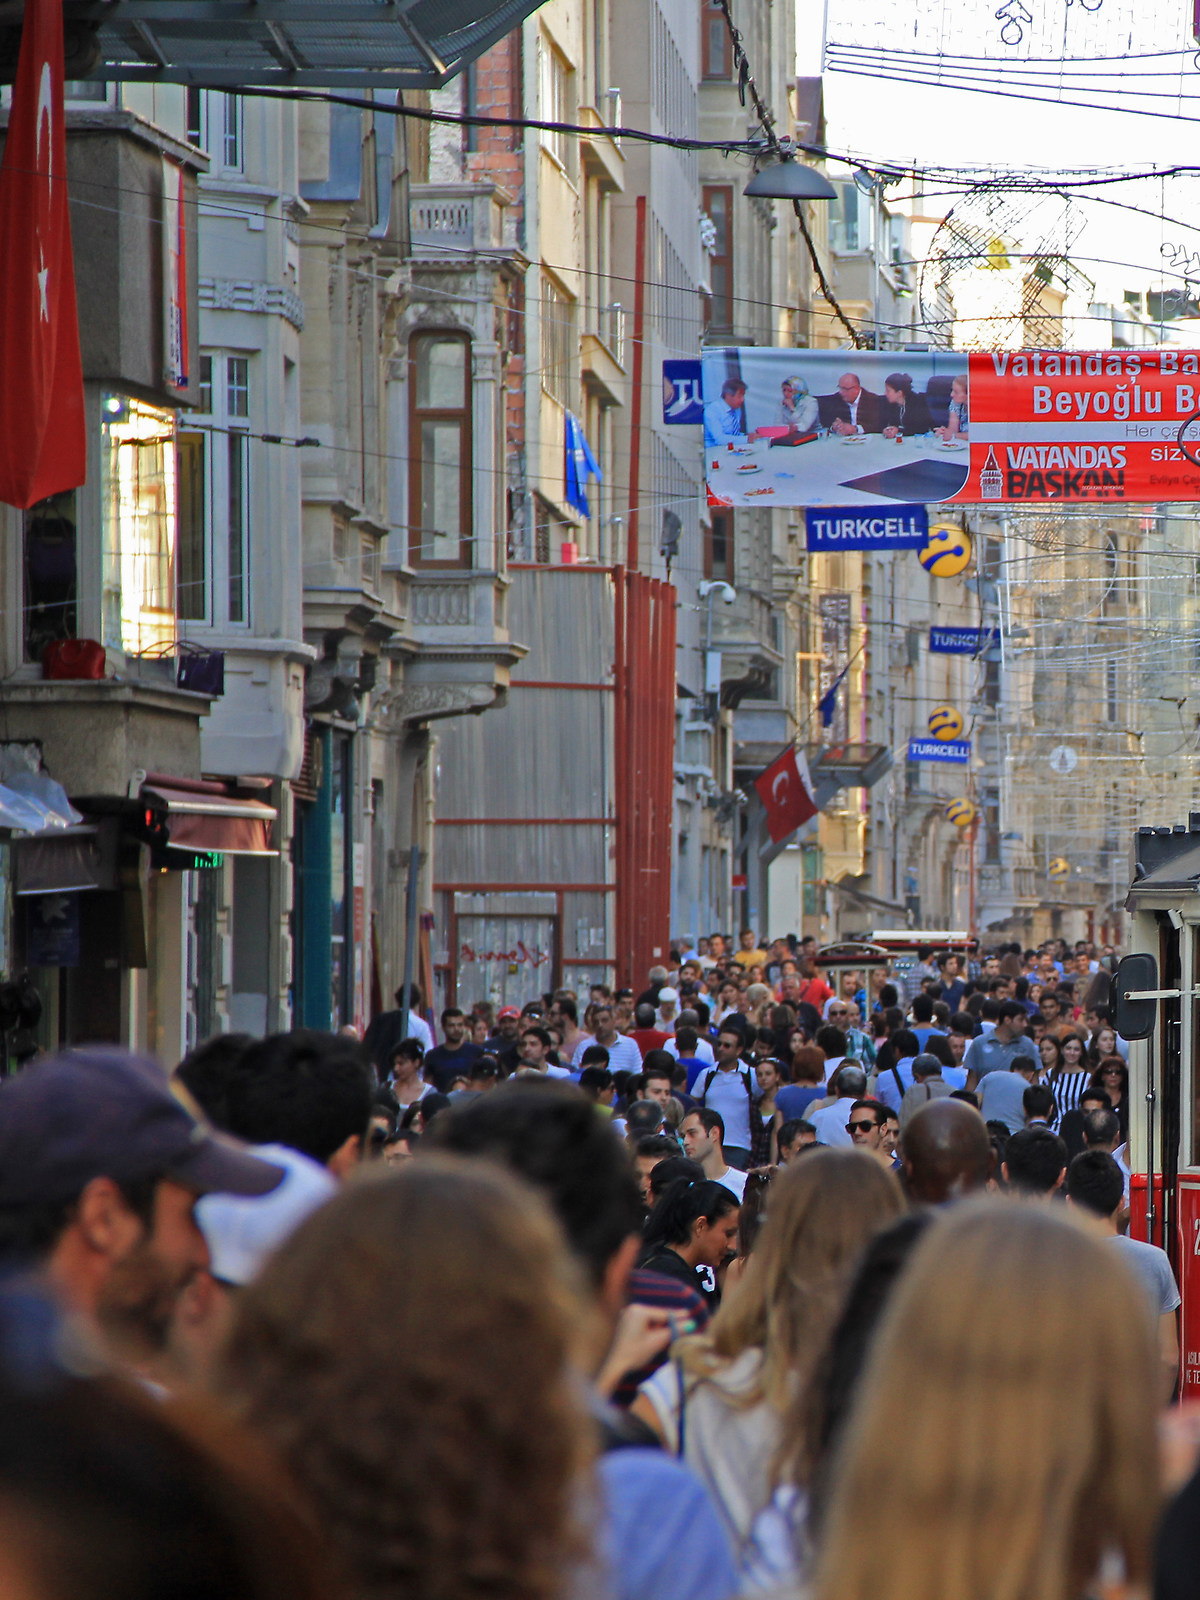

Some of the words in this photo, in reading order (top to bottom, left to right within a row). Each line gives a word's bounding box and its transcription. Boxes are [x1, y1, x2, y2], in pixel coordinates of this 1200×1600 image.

[1032, 383, 1162, 420] Beyoğlu
[1125, 424, 1156, 437] Her
[811, 517, 922, 540] TURKCELL
[932, 632, 984, 648] TURKC
[910, 743, 970, 758] TURKCELL
